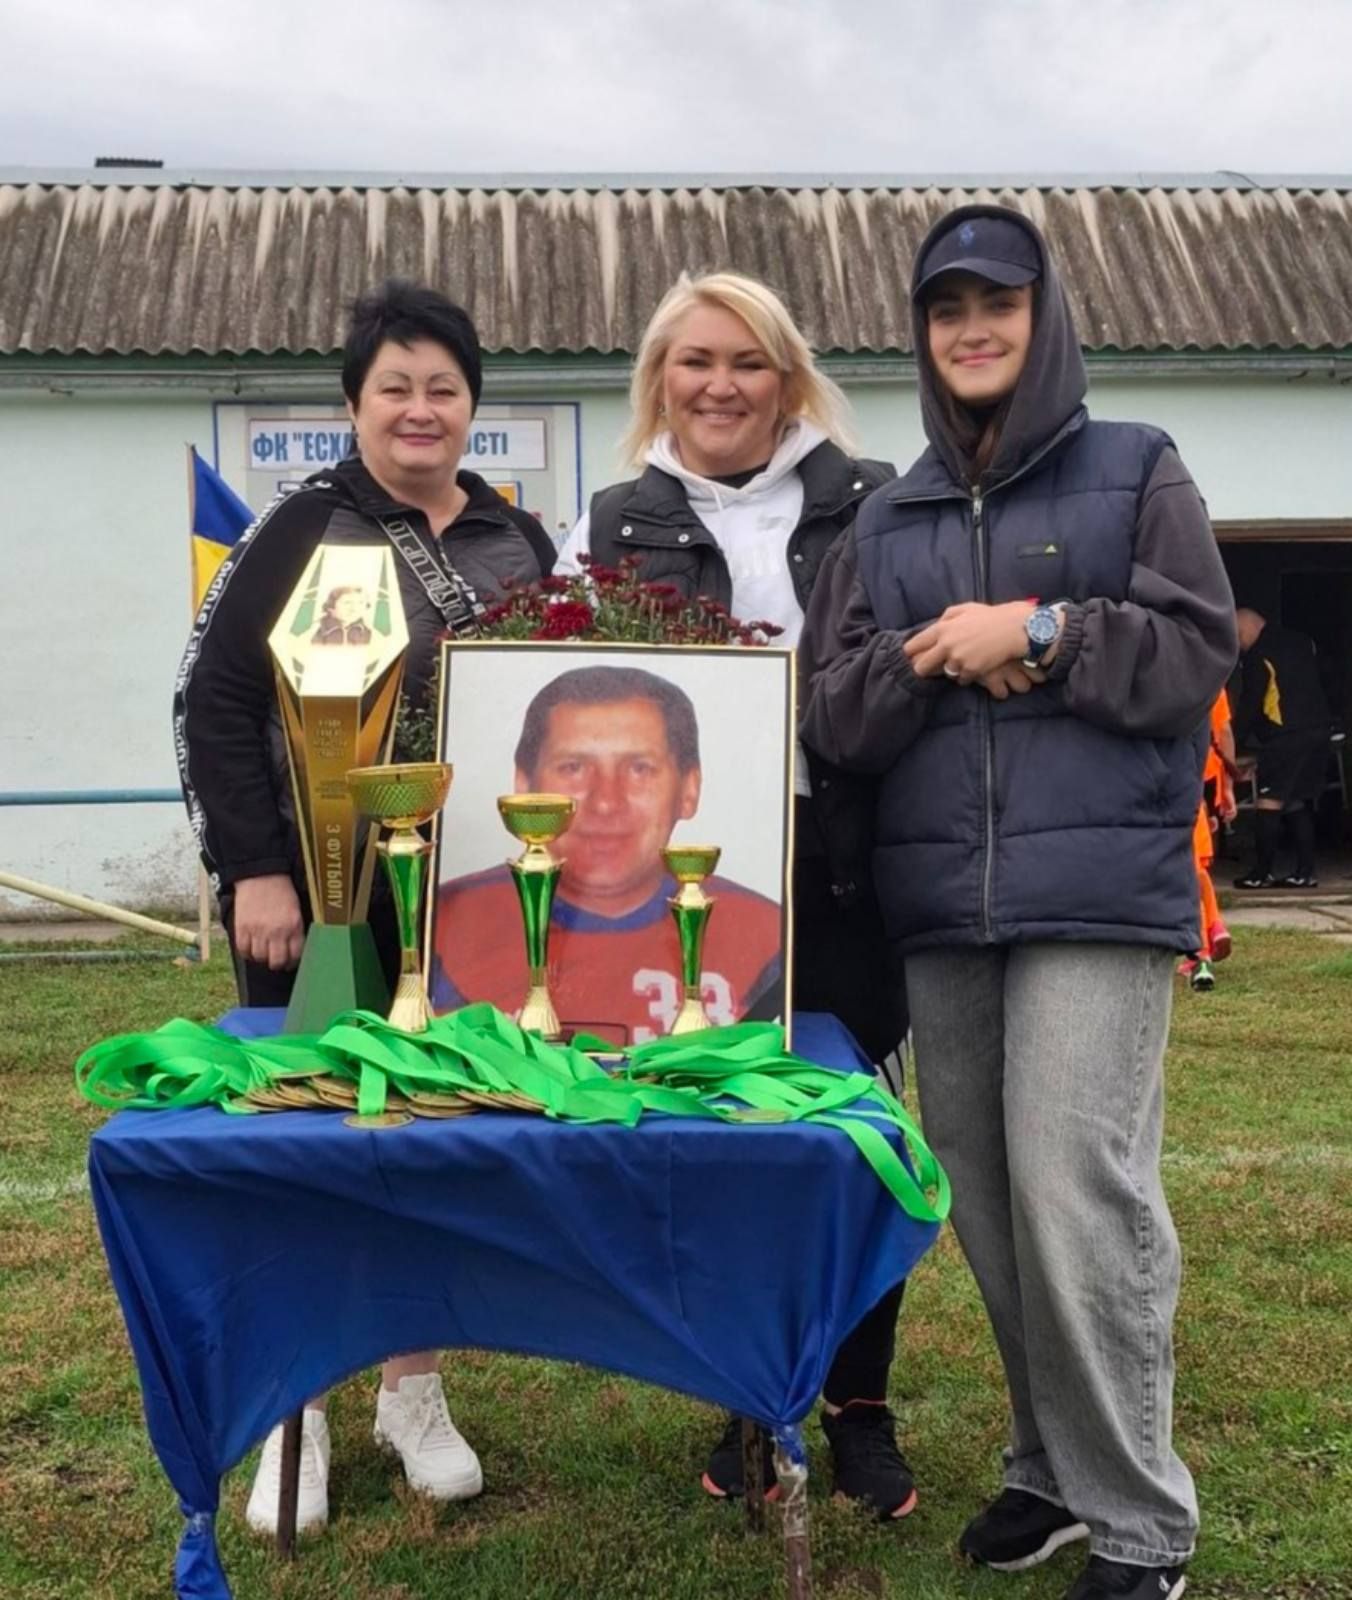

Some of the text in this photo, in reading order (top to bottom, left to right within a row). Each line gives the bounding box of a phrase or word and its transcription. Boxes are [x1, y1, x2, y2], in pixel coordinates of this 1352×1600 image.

[253, 432, 288, 461] ФК
[174, 560, 234, 692] MONEY STUDIO
[327, 837, 343, 908] ФУТБОЛУ
